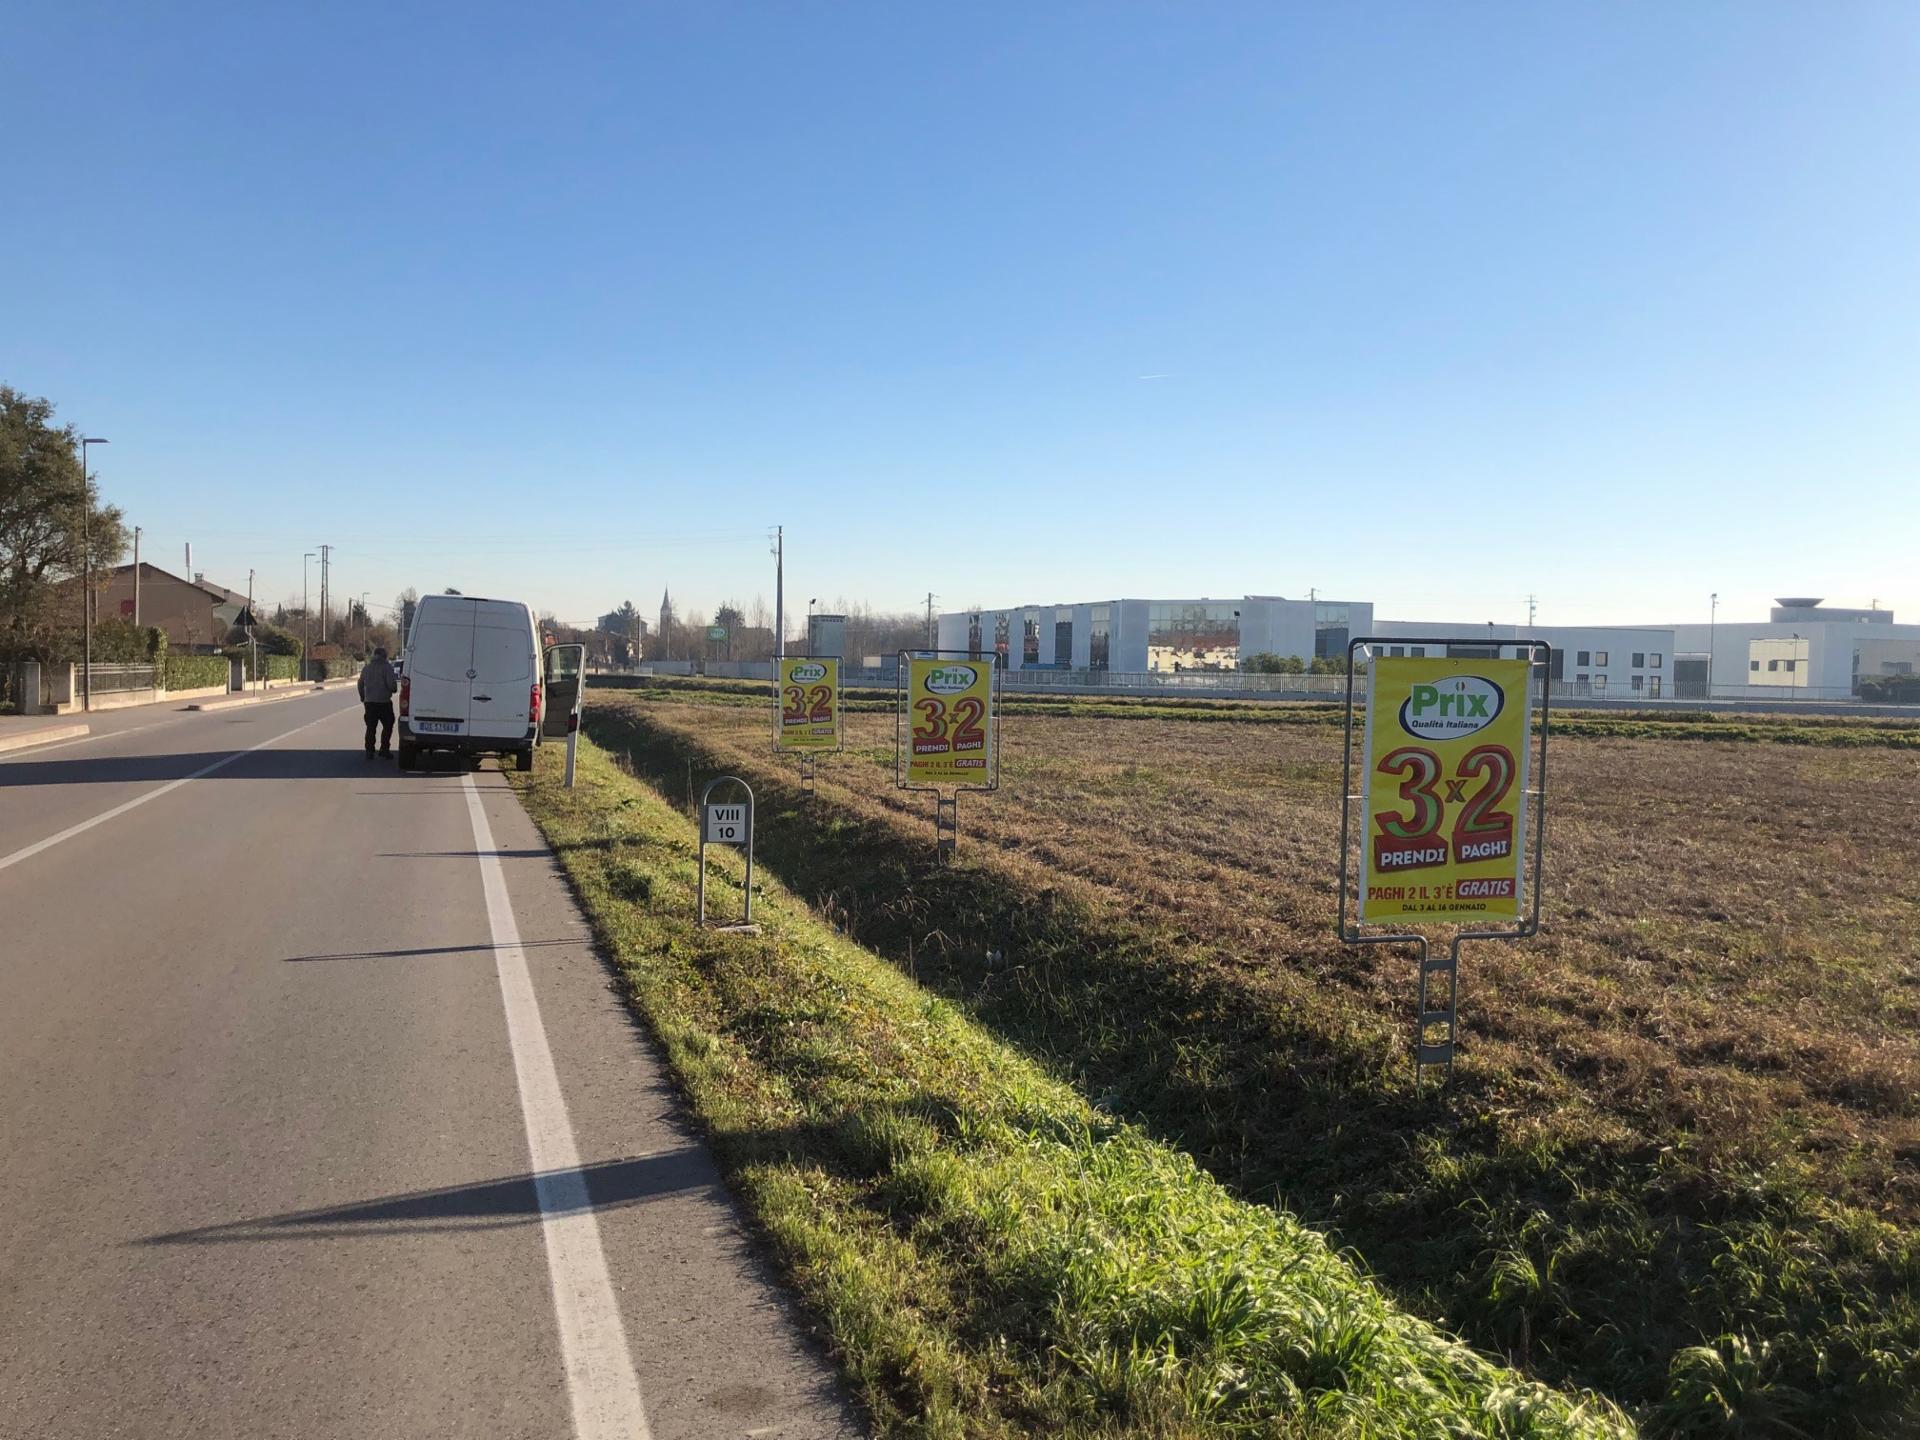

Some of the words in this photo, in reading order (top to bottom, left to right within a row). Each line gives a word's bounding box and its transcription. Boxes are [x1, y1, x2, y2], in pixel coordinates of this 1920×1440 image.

[795, 666, 821, 677] Prix
[930, 667, 969, 685] Prix
[1411, 682, 1489, 718] Prix
[1412, 720, 1444, 729] Qualità
[1446, 720, 1479, 729] Italiana
[916, 744, 948, 753] PRENDI
[956, 741, 981, 750] PAGHI
[956, 760, 983, 768] GRATIS
[715, 809, 740, 821] VIII
[719, 827, 735, 839] 10
[1381, 848, 1446, 867] PRENDI
[1461, 840, 1507, 859] PAGHI
[1368, 886, 1405, 900] PAGHI
[1408, 886, 1416, 899] 2
[1419, 886, 1430, 899] IL
[1458, 880, 1511, 896] GRATIS
[1402, 903, 1418, 912] DAL
[1448, 903, 1487, 911] GENNAIO
